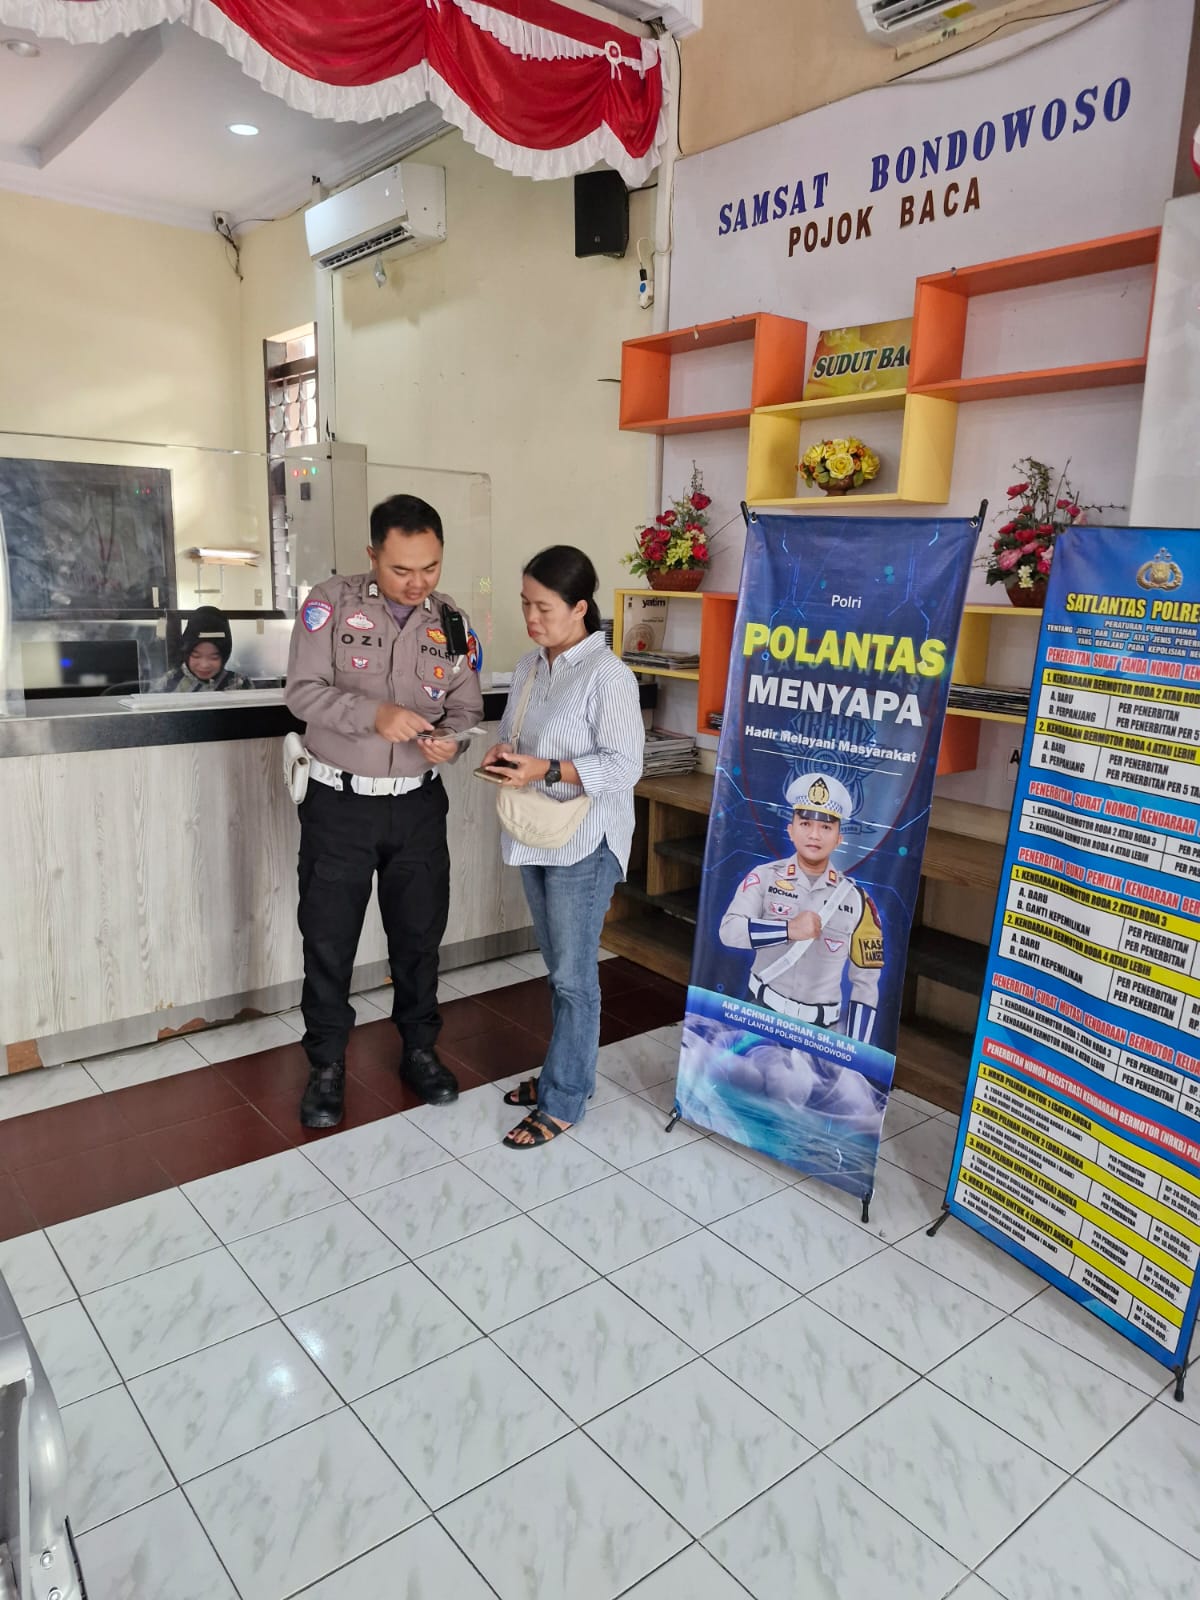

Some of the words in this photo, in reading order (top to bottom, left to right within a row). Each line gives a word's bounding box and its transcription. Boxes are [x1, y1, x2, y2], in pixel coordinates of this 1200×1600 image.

[719, 172, 829, 236] SAMSAT
[870, 76, 1132, 192] BONDOWOSO
[788, 205, 873, 257] POJOK
[899, 176, 981, 228] BACA
[813, 349, 878, 378] SUDUT
[831, 594, 862, 609] Polri
[1066, 593, 1147, 619] SATLANTAS
[1151, 600, 1200, 623] POLRE
[1047, 624, 1073, 634] TENTANG
[1076, 627, 1092, 636] JENIS
[1112, 631, 1131, 640] TARIF
[1133, 634, 1150, 643] ATAS
[1152, 636, 1172, 645] JENIS
[1104, 620, 1143, 631] PERATURAN
[341, 633, 383, 648] OZI
[742, 622, 947, 677] POLANTAS
[1094, 640, 1124, 650] BERLAKU
[1127, 644, 1146, 652] PADA
[1148, 647, 1187, 657] KEPOLISIAN
[1046, 647, 1092, 667] PENERBITAN
[1092, 652, 1119, 671] SURAT
[1120, 656, 1149, 674] TANDA
[1149, 660, 1183, 679] NOMOR
[748, 674, 924, 728] MENYAPA
[1057, 692, 1074, 705] BARU
[1133, 685, 1155, 698] RODA
[1156, 688, 1162, 699] 2
[1162, 689, 1183, 702] ATAU
[1055, 706, 1096, 723] PERPANJANG
[1118, 703, 1133, 715] PER
[1133, 705, 1180, 722] PENERBITAN
[1116, 717, 1130, 729] PER
[1130, 719, 1177, 737] PENERBITAN
[1178, 727, 1193, 740] PER
[1193, 730, 1200, 741] 5
[745, 725, 780, 742] Hadir
[780, 729, 838, 751] Melayani
[838, 740, 918, 765] Masyarakat
[1083, 730, 1125, 747] BERMOTOR
[1125, 737, 1145, 751] RODA
[1146, 741, 1152, 752] 4
[1152, 743, 1173, 756] ATAU
[1173, 746, 1197, 760] LEBIH
[1049, 755, 1086, 773] PERPANJANG
[1108, 754, 1123, 766] PER
[1123, 757, 1170, 776] PENERBITAN
[1106, 768, 1120, 780] PER
[1121, 771, 1167, 790] PENERBITAN
[1167, 781, 1182, 794] PER
[1182, 784, 1189, 795] 5
[1028, 780, 1074, 806] PENERBITAN
[1073, 792, 1104, 813] SURAT
[1103, 799, 1140, 822] NOMOR
[1139, 807, 1198, 836] KENDARAAN
[1094, 822, 1112, 835] RODA
[1112, 827, 1118, 837] 2
[1118, 829, 1134, 841] ATAU
[1134, 833, 1151, 846] RODA
[1151, 837, 1158, 847] 3
[1110, 844, 1115, 853] 4
[1114, 845, 1131, 858] ATAU
[1178, 844, 1191, 856] PER
[1018, 846, 1065, 874] PENERBITAN
[1065, 861, 1086, 882] BUKU
[1086, 868, 1124, 893] PEMILIK
[1123, 879, 1181, 911] KENDARAAN
[1174, 862, 1188, 873] PER
[768, 885, 799, 900] ROCHAN
[1019, 887, 1026, 898] A.
[1027, 889, 1049, 904] BARU
[824, 899, 854, 915] LRI
[1017, 900, 1024, 911] B.
[1026, 902, 1049, 918] GANTI
[1048, 910, 1091, 937] KEPEMILIKAN
[1112, 901, 1119, 912] 2
[1118, 903, 1139, 918] ATAU
[1161, 915, 1167, 927] 3
[1011, 932, 1018, 943] A.
[1020, 935, 1040, 951] BARU
[1128, 925, 1142, 938] PER
[1143, 930, 1189, 954] PENERBITAN
[1009, 945, 1016, 956] B.
[1018, 948, 1040, 965] GANTI
[1040, 957, 1083, 984] KEPEMILIKAN
[1103, 951, 1109, 962] 4
[1108, 954, 1129, 969] ATAU
[1129, 960, 1152, 977] LEBIH
[1124, 939, 1139, 952] PER
[1140, 944, 1186, 969] PENERBITAN
[1113, 990, 1128, 1003] PER
[1129, 994, 1175, 1021] PENERBITAN
[1116, 976, 1131, 989] PER
[1132, 980, 1178, 1007] PENERBITAN
[722, 1000, 740, 1012] AKP
[741, 1007, 777, 1025] ACHMAT
[776, 1018, 816, 1041] ROCHAN,
[836, 1040, 858, 1055] M.M.
[992, 972, 1036, 1001] PENERBITAN
[1035, 988, 1059, 1011] SURAT
[1058, 999, 1084, 1024] MUTASI
[1083, 1012, 1128, 1045] KENDARAAN
[1127, 1031, 1175, 1064] BERMOTOR
[724, 1011, 747, 1024] KASAT
[747, 1019, 775, 1035] LANTAS
[774, 1029, 804, 1045] POLRES
[804, 1038, 853, 1062] BONDOWOSO
[1125, 1057, 1139, 1069] PER
[1138, 1062, 1178, 1086] PENERBITAN
[1024, 1059, 1048, 1079] NOMOR
[1046, 1070, 1083, 1099] REGISTRASI
[1119, 1110, 1160, 1140] BERMOTOR
[1121, 1073, 1135, 1086] PER
[1134, 1078, 1175, 1103] PENERBITAN
